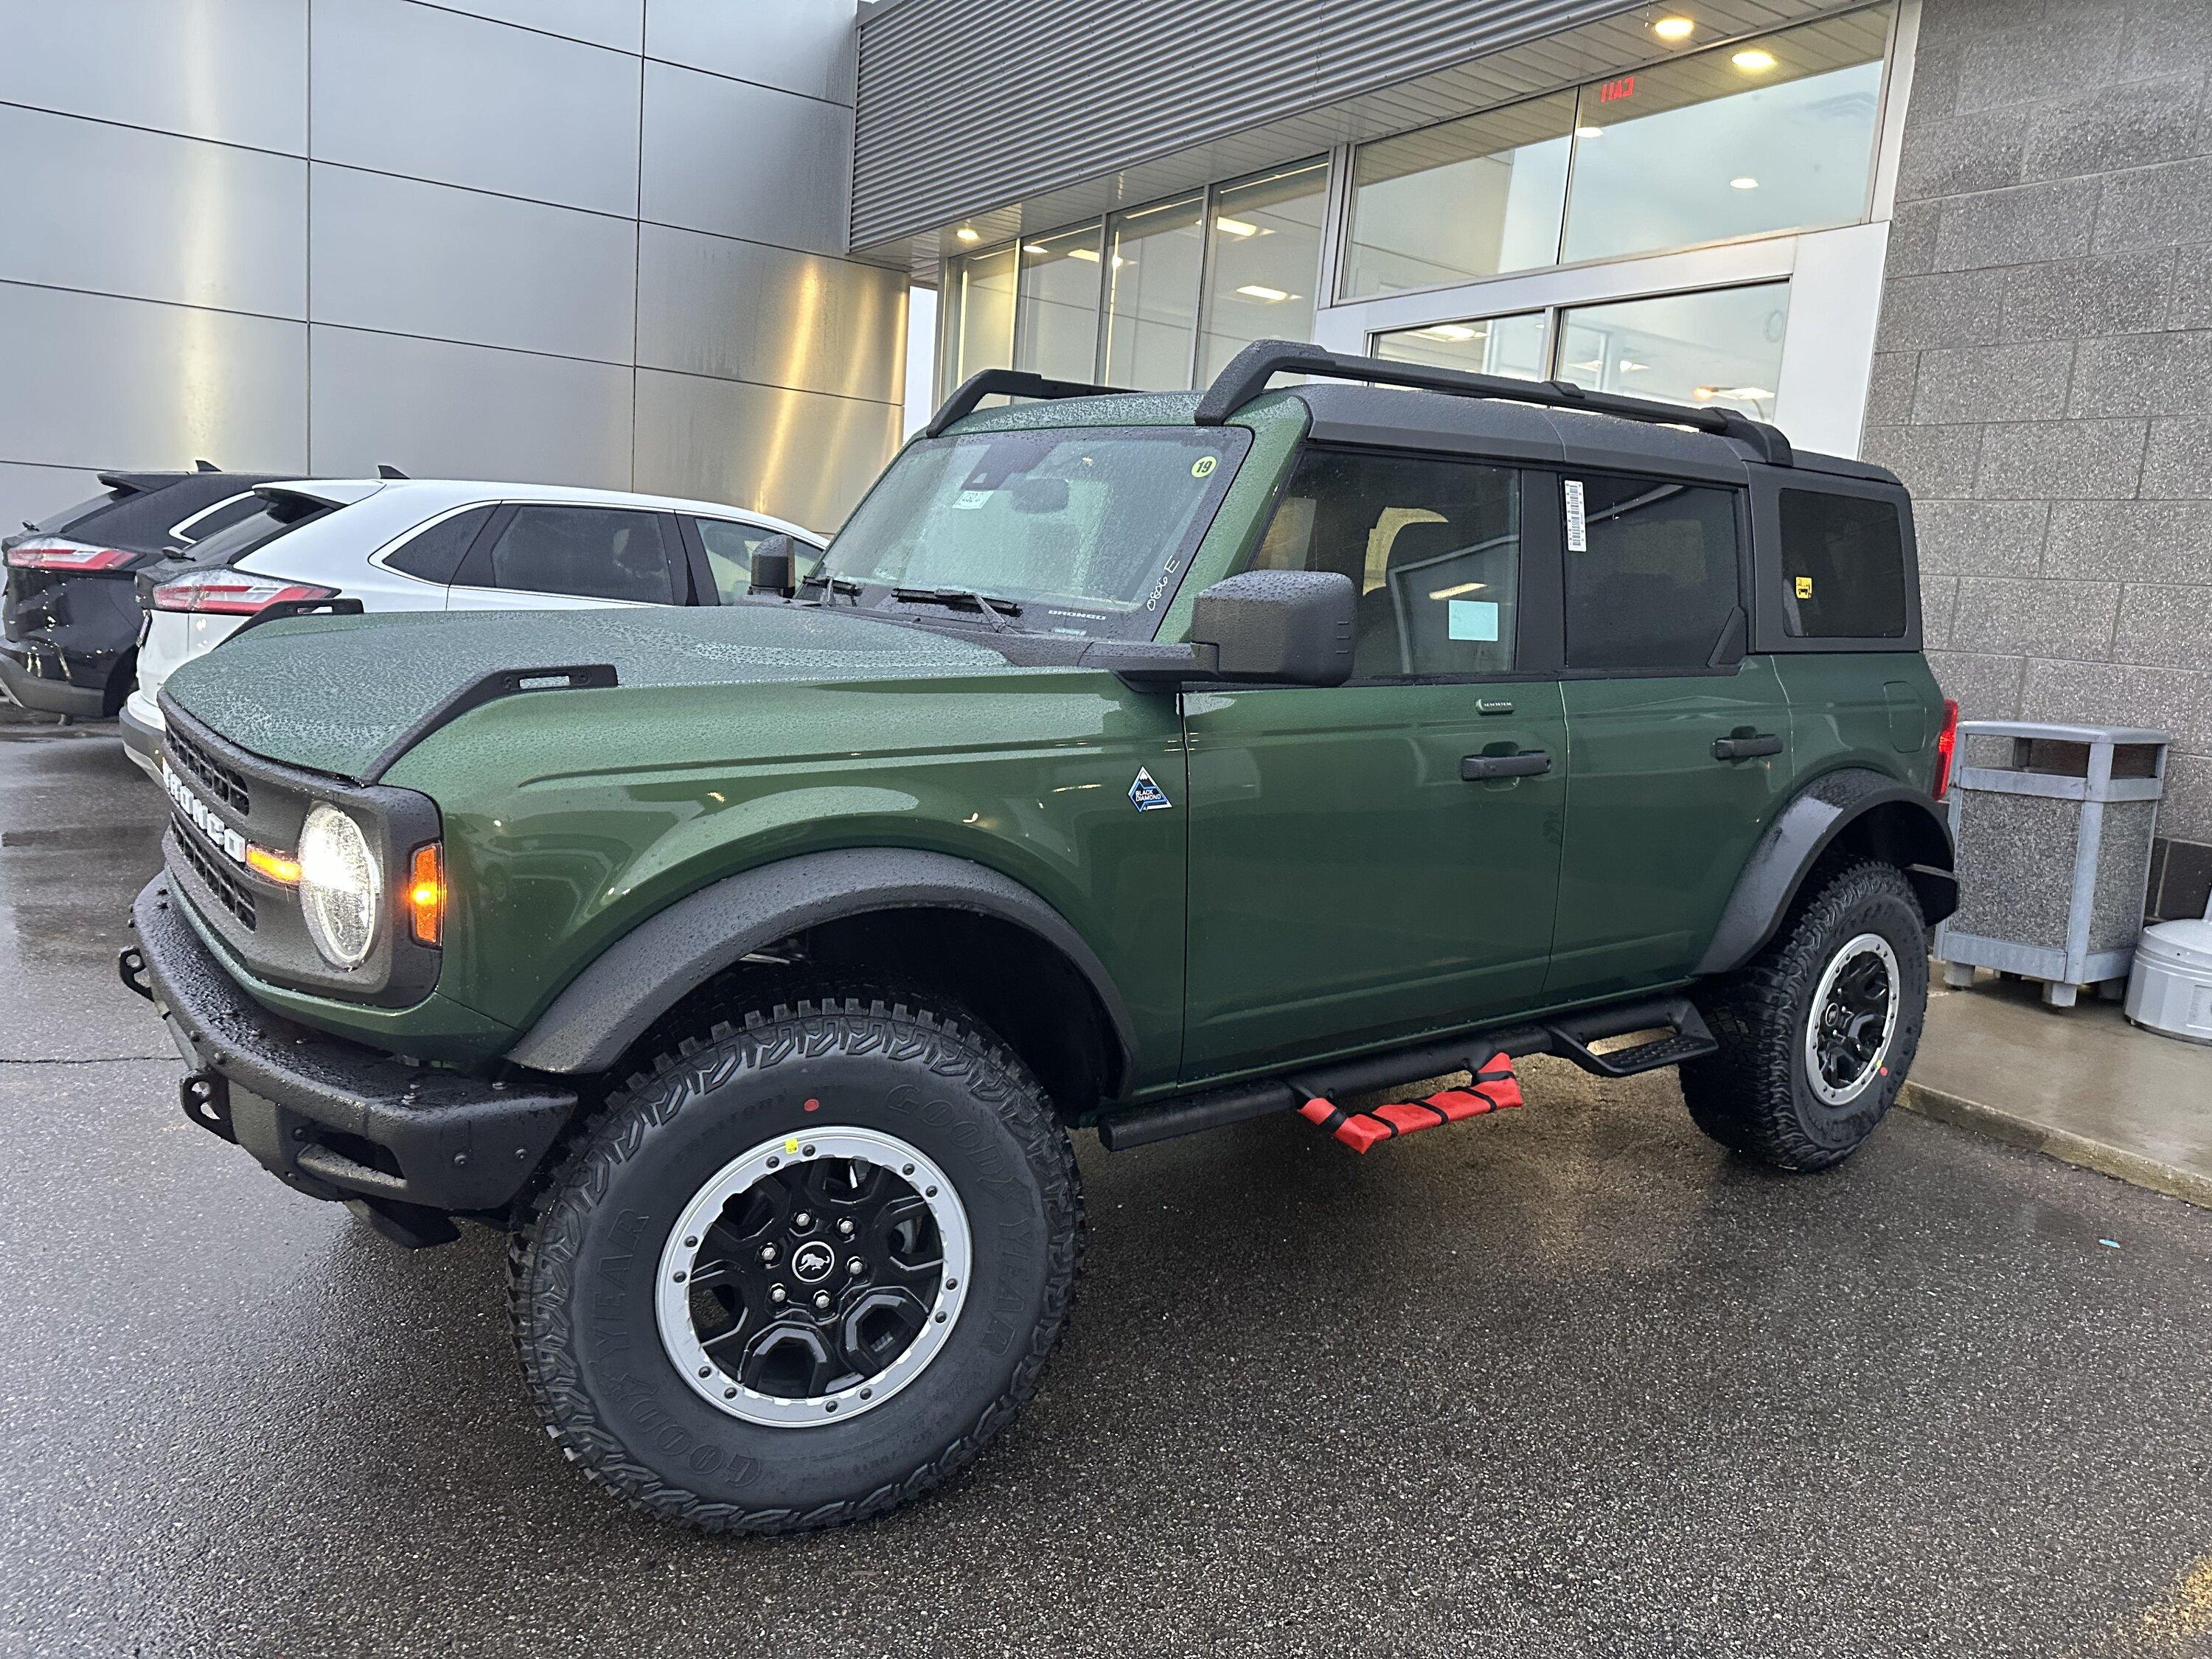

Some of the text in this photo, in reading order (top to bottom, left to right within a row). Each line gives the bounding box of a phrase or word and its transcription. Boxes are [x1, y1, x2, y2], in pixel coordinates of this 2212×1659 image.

[1196, 461, 1213, 473] 19
[1164, 555, 1180, 574] E
[1048, 610, 1107, 621] BRONCO
